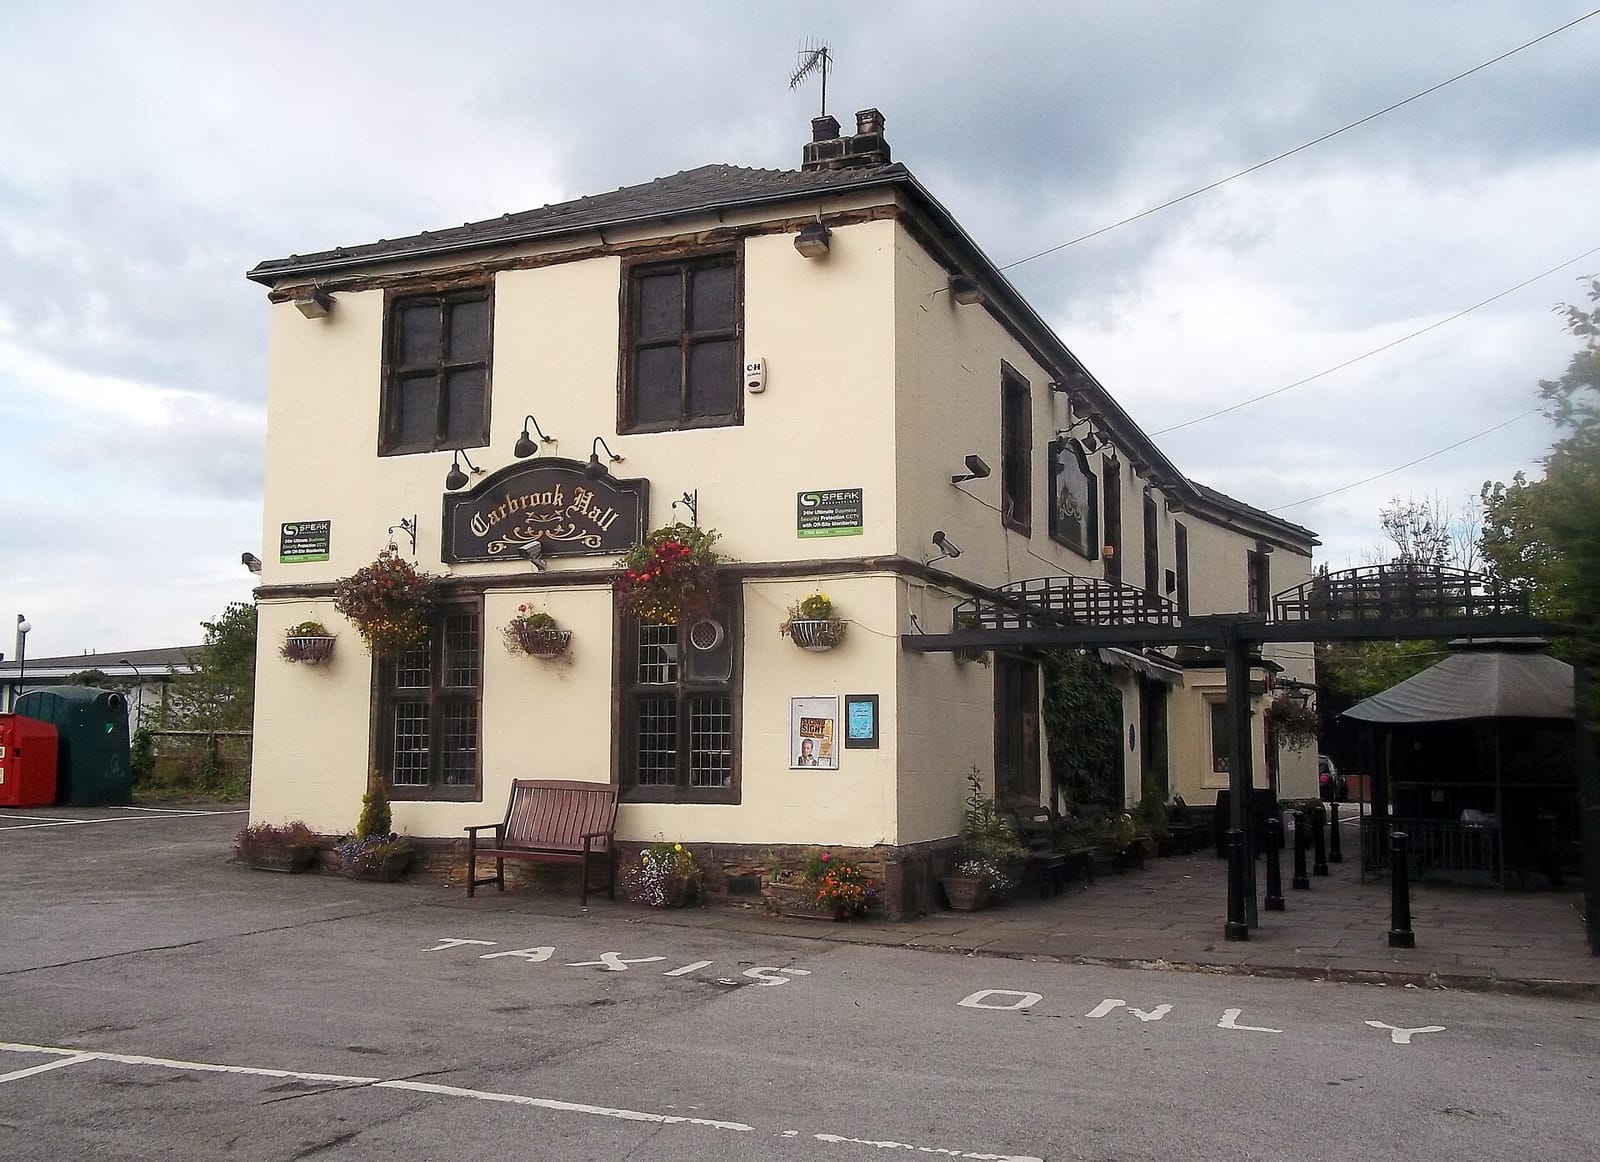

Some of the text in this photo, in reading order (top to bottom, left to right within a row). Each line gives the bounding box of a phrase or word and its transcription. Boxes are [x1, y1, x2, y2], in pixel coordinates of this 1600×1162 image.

[747, 363, 760, 371] CH
[822, 491, 859, 501] SPEAK
[470, 483, 620, 537] Carbrook Hall
[299, 523, 327, 531] SPEAK
[801, 725, 825, 733] SIGHT
[421, 937, 1447, 1044] TAXIS ONLY
